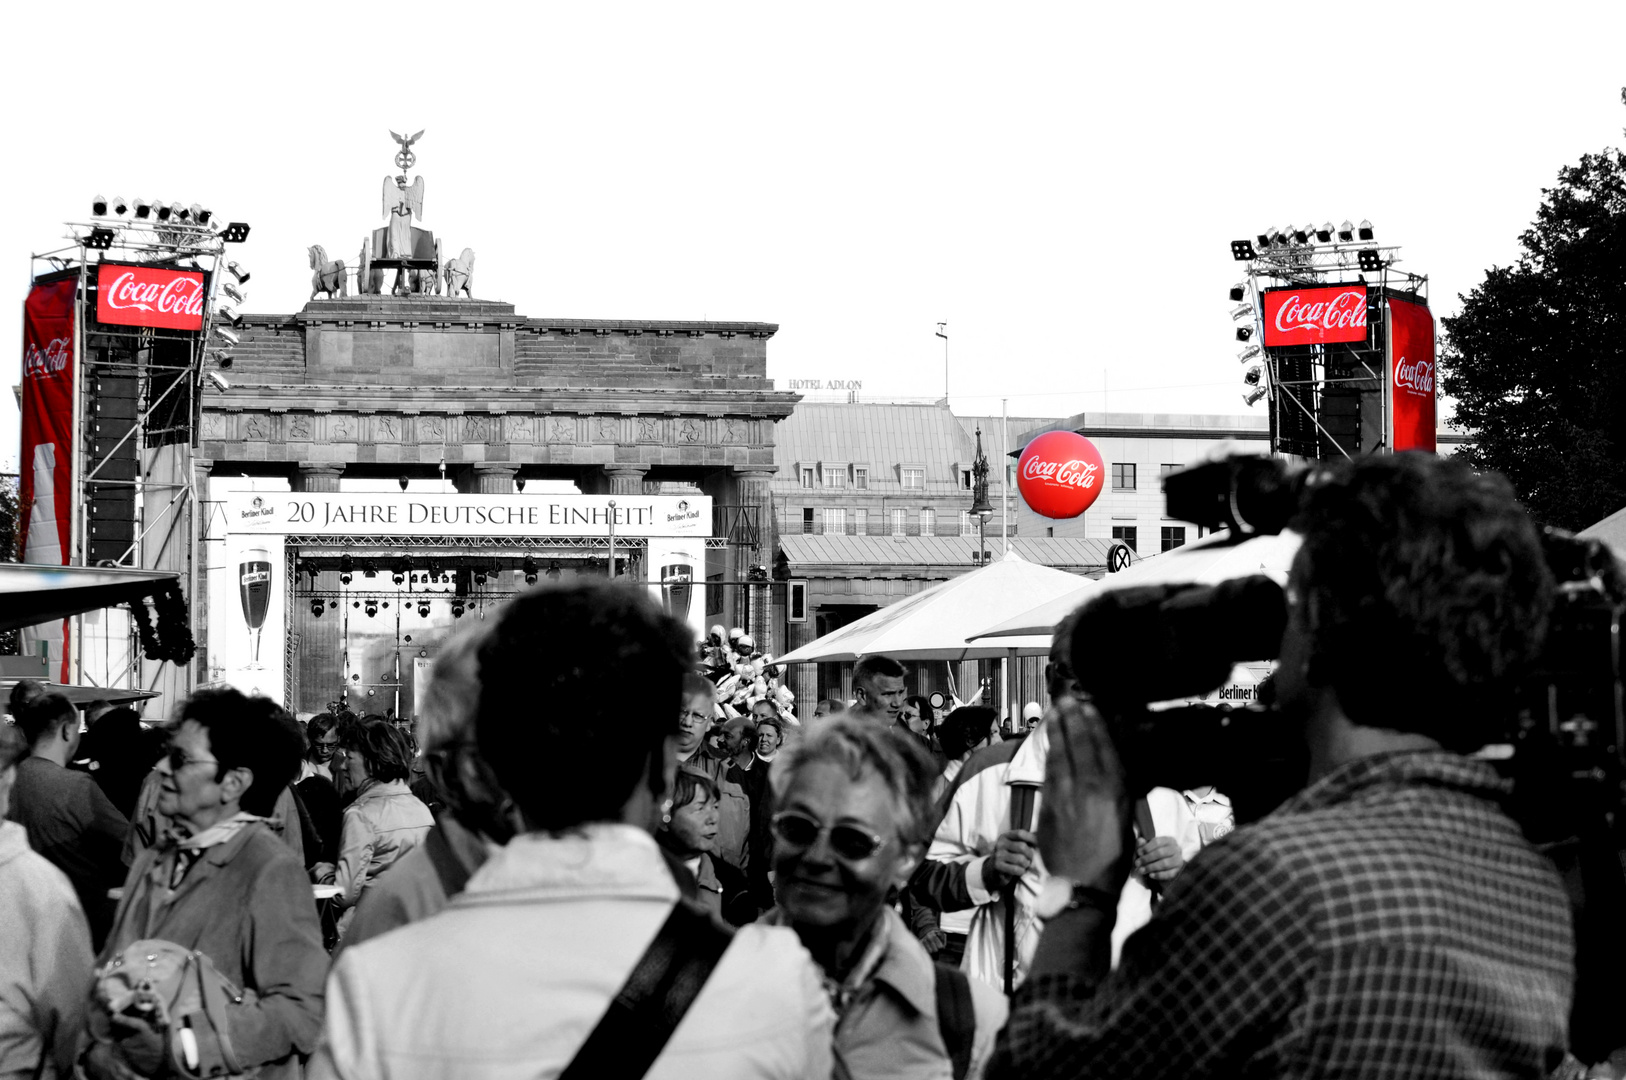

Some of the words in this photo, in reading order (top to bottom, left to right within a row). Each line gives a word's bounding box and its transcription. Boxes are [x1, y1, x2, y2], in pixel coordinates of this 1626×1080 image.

[107, 272, 203, 315] Coca-Cola
[1275, 292, 1367, 332] Coca-Cola
[788, 379, 823, 390] HOTEL
[826, 380, 862, 390] ADLON
[1394, 356, 1433, 392] Coca-Cola
[1023, 455, 1098, 489] Coca-Cola
[287, 502, 315, 522] 20
[1219, 684, 1252, 699] Berliner
